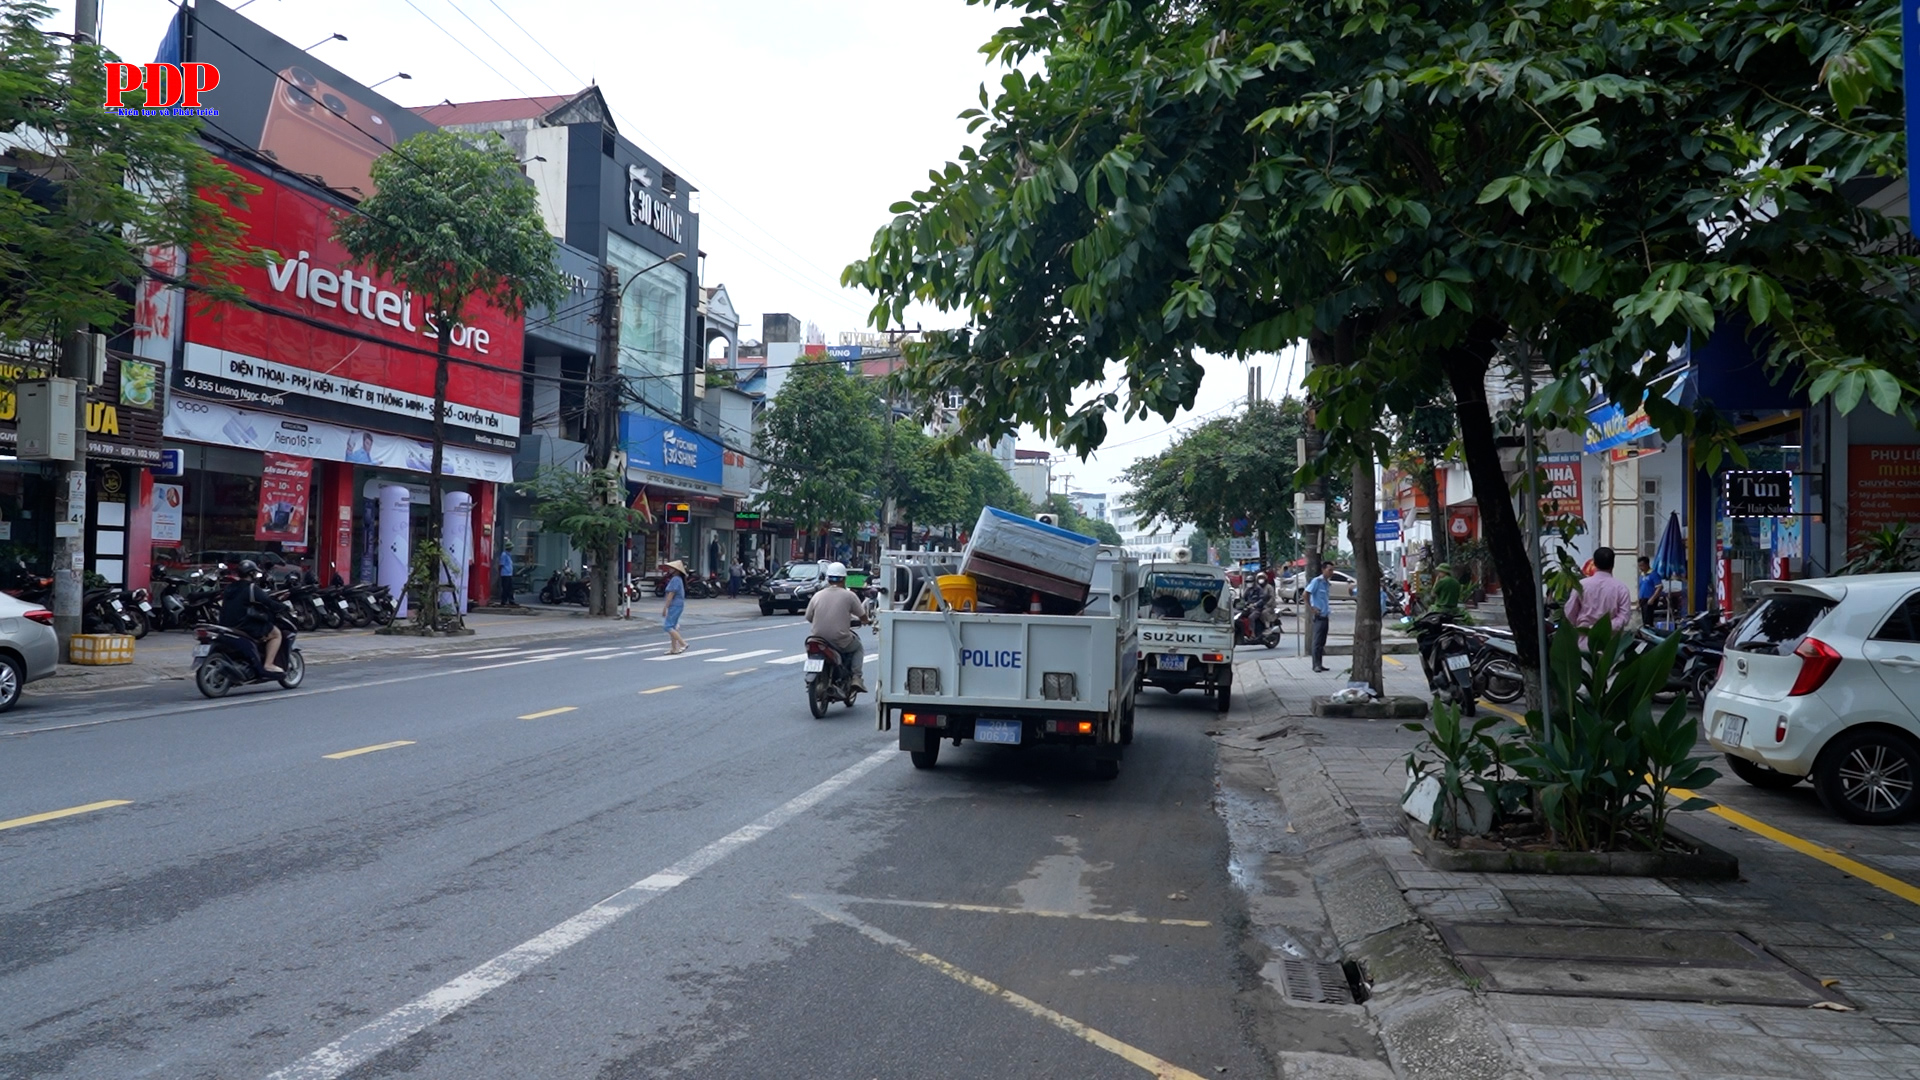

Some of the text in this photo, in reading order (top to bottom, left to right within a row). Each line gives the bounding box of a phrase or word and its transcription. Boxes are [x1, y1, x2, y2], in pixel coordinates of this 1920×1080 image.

[638, 190, 651, 225] 30
[266, 250, 416, 332] viettel
[184, 375, 196, 389] Số
[197, 379, 214, 393] 355
[230, 360, 254, 377] ĐIỆN
[256, 366, 286, 385] THOẠI
[291, 374, 312, 391] PHỤ
[313, 379, 334, 395] KIỆN
[340, 383, 364, 400] THIẾT
[366, 390, 375, 405] BỊ
[376, 391, 404, 408] THÔNG
[1871, 449, 1900, 464] PHỤ
[1737, 476, 1781, 497] Tún
[1747, 503, 1789, 514] Hair Salon
[1142, 632, 1203, 643] SUZUKI
[962, 649, 1022, 668] POLICE
